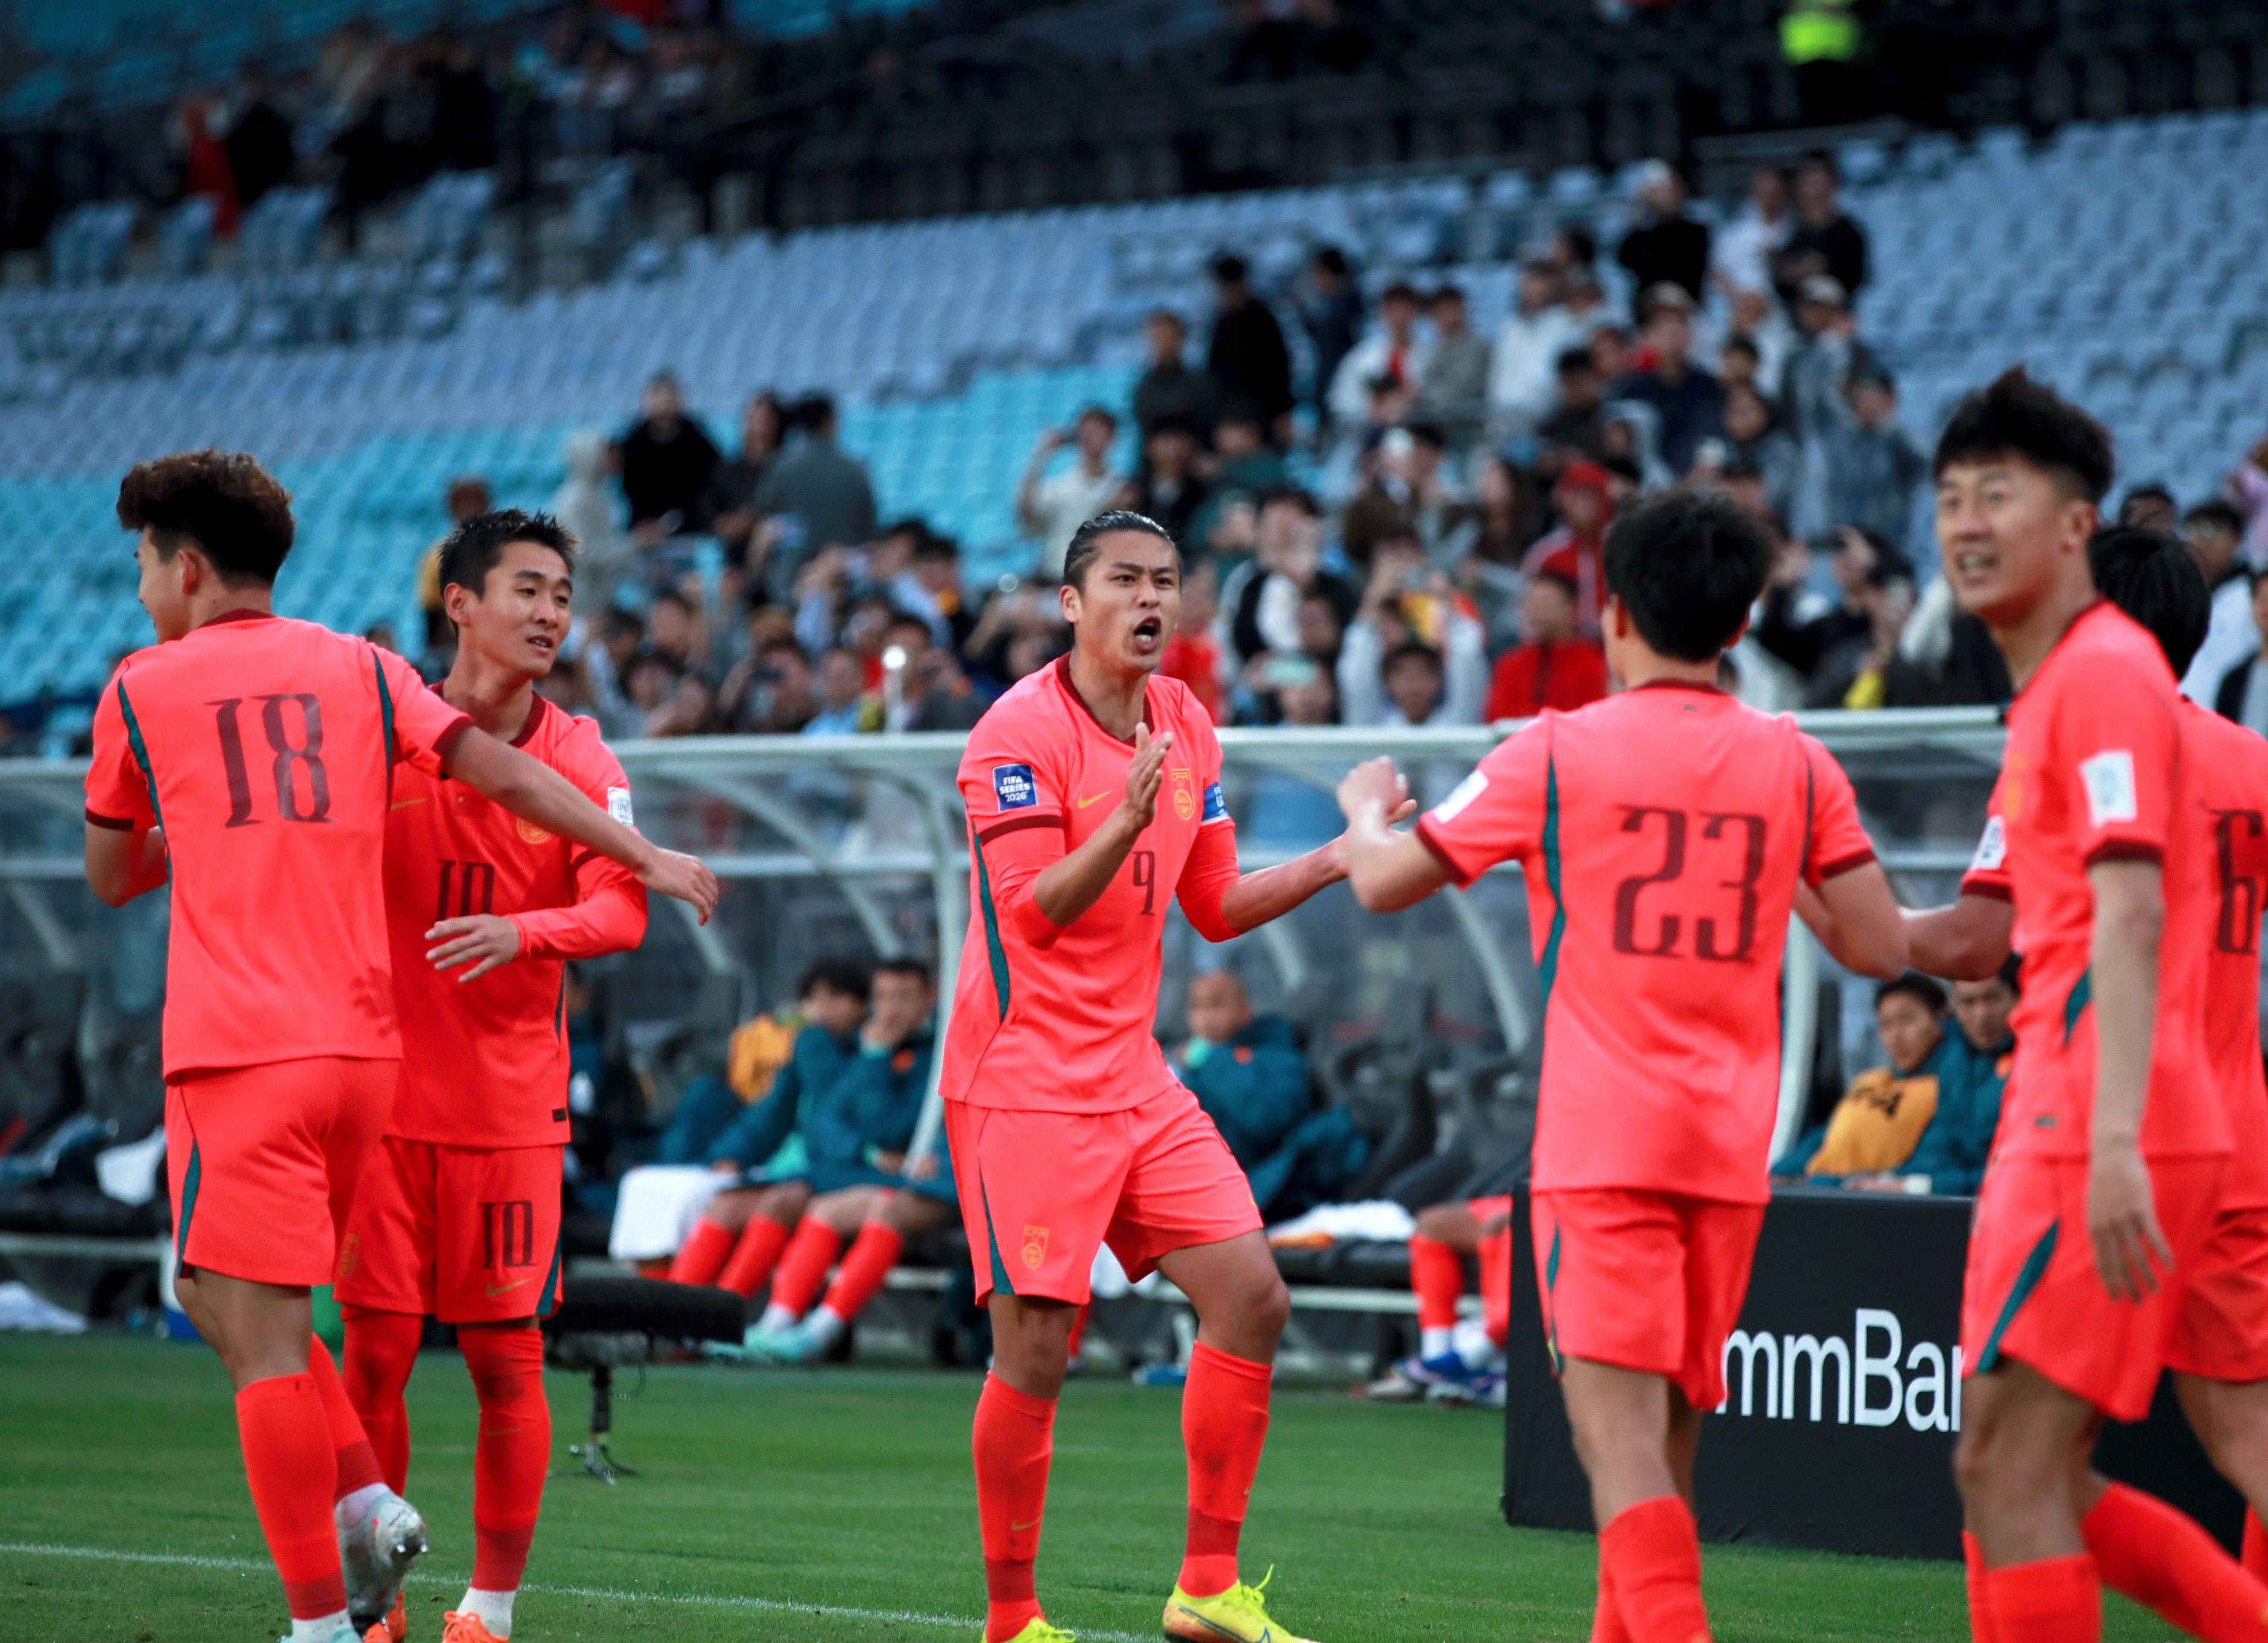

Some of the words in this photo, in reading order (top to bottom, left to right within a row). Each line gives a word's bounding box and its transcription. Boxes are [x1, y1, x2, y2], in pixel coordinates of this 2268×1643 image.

[204, 693, 338, 829] 18
[999, 783, 1031, 794] SERIES
[1003, 776, 1024, 785] FIFA
[1005, 791, 1028, 802] 2026
[1131, 850, 1156, 916] 9
[1613, 803, 1767, 964] 23
[477, 1199, 536, 1270] 10
